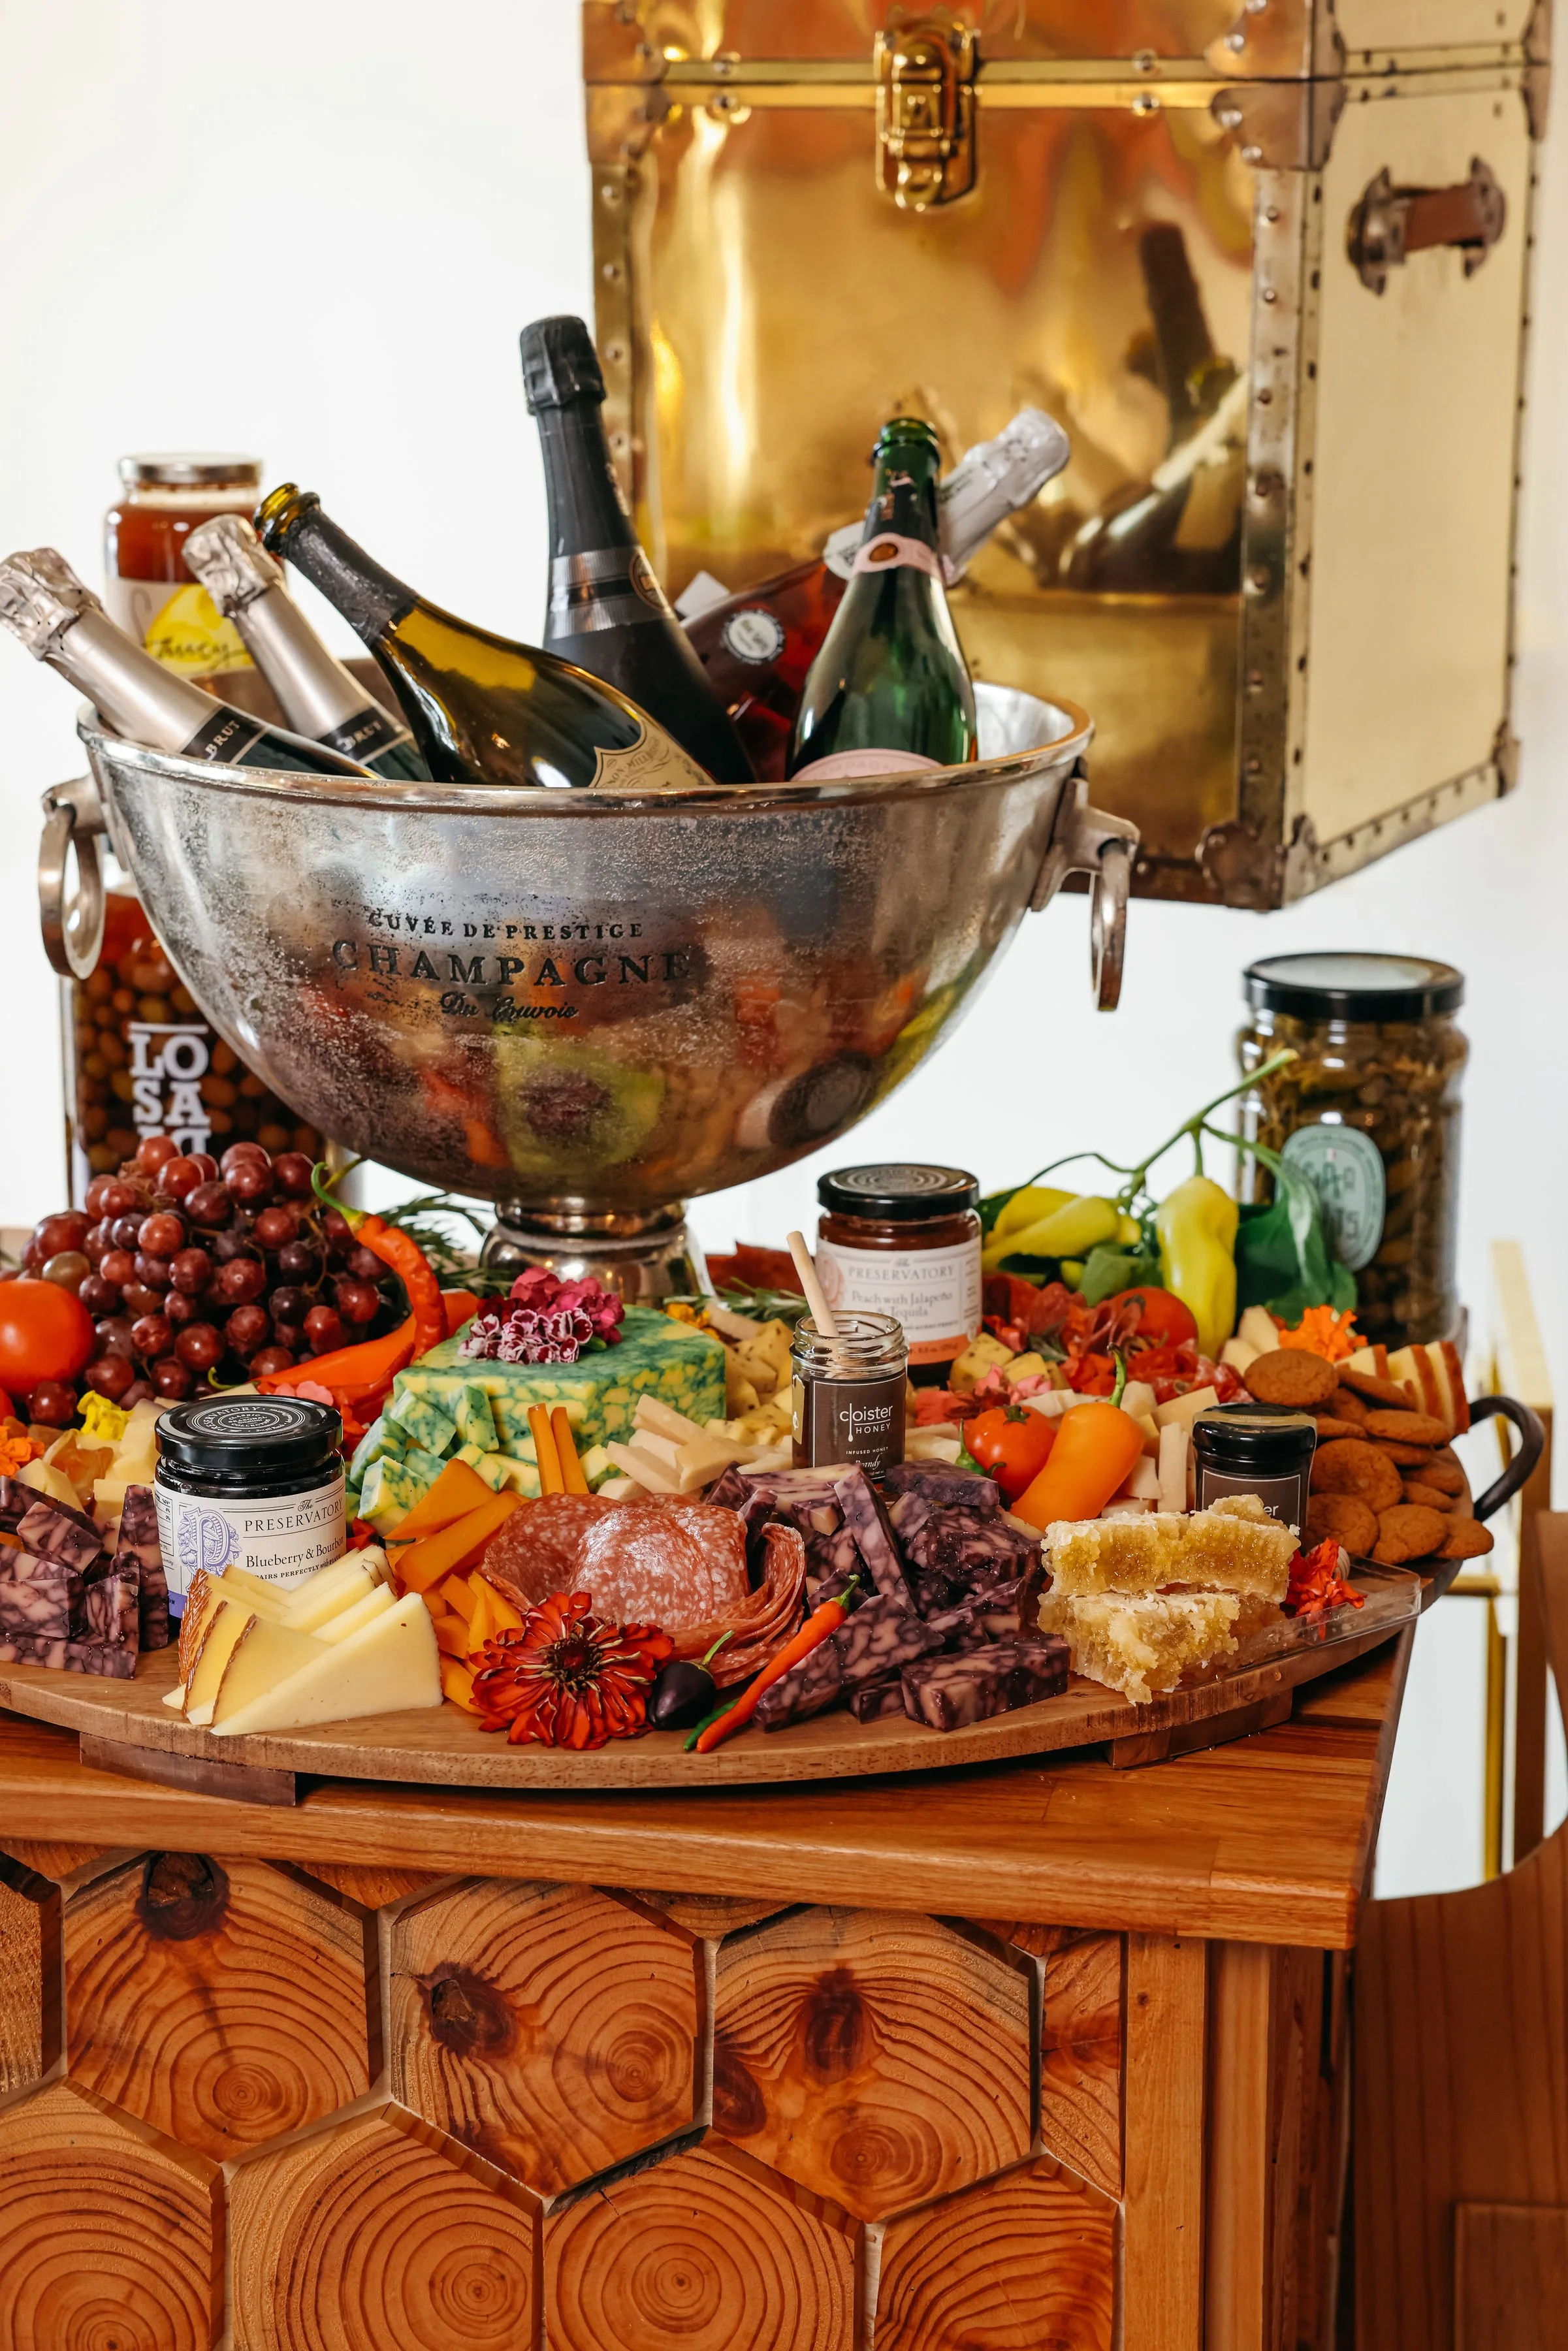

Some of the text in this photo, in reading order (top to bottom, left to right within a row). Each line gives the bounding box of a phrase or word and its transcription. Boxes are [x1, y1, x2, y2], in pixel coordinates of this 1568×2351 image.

[204, 720, 240, 759] BRUT
[368, 910, 643, 940] CUVÉE DE PRESTIGE
[332, 940, 690, 987] CHAMPAGNE
[848, 1264, 955, 1281] PRESERVATORY
[852, 1290, 953, 1307] Peach with Jalapeño
[890, 1305, 929, 1322] Tequila
[203, 1407, 261, 1431] PRESERVATORY
[840, 1403, 893, 1422] cloister
[856, 1423, 891, 1434] HONEY
[244, 1497, 343, 1532] PRESERVATORY
[298, 1499, 313, 1512] The
[246, 1535, 345, 1567] Blueberry & Bourbon
[280, 1565, 319, 1578] PERFECTLY
